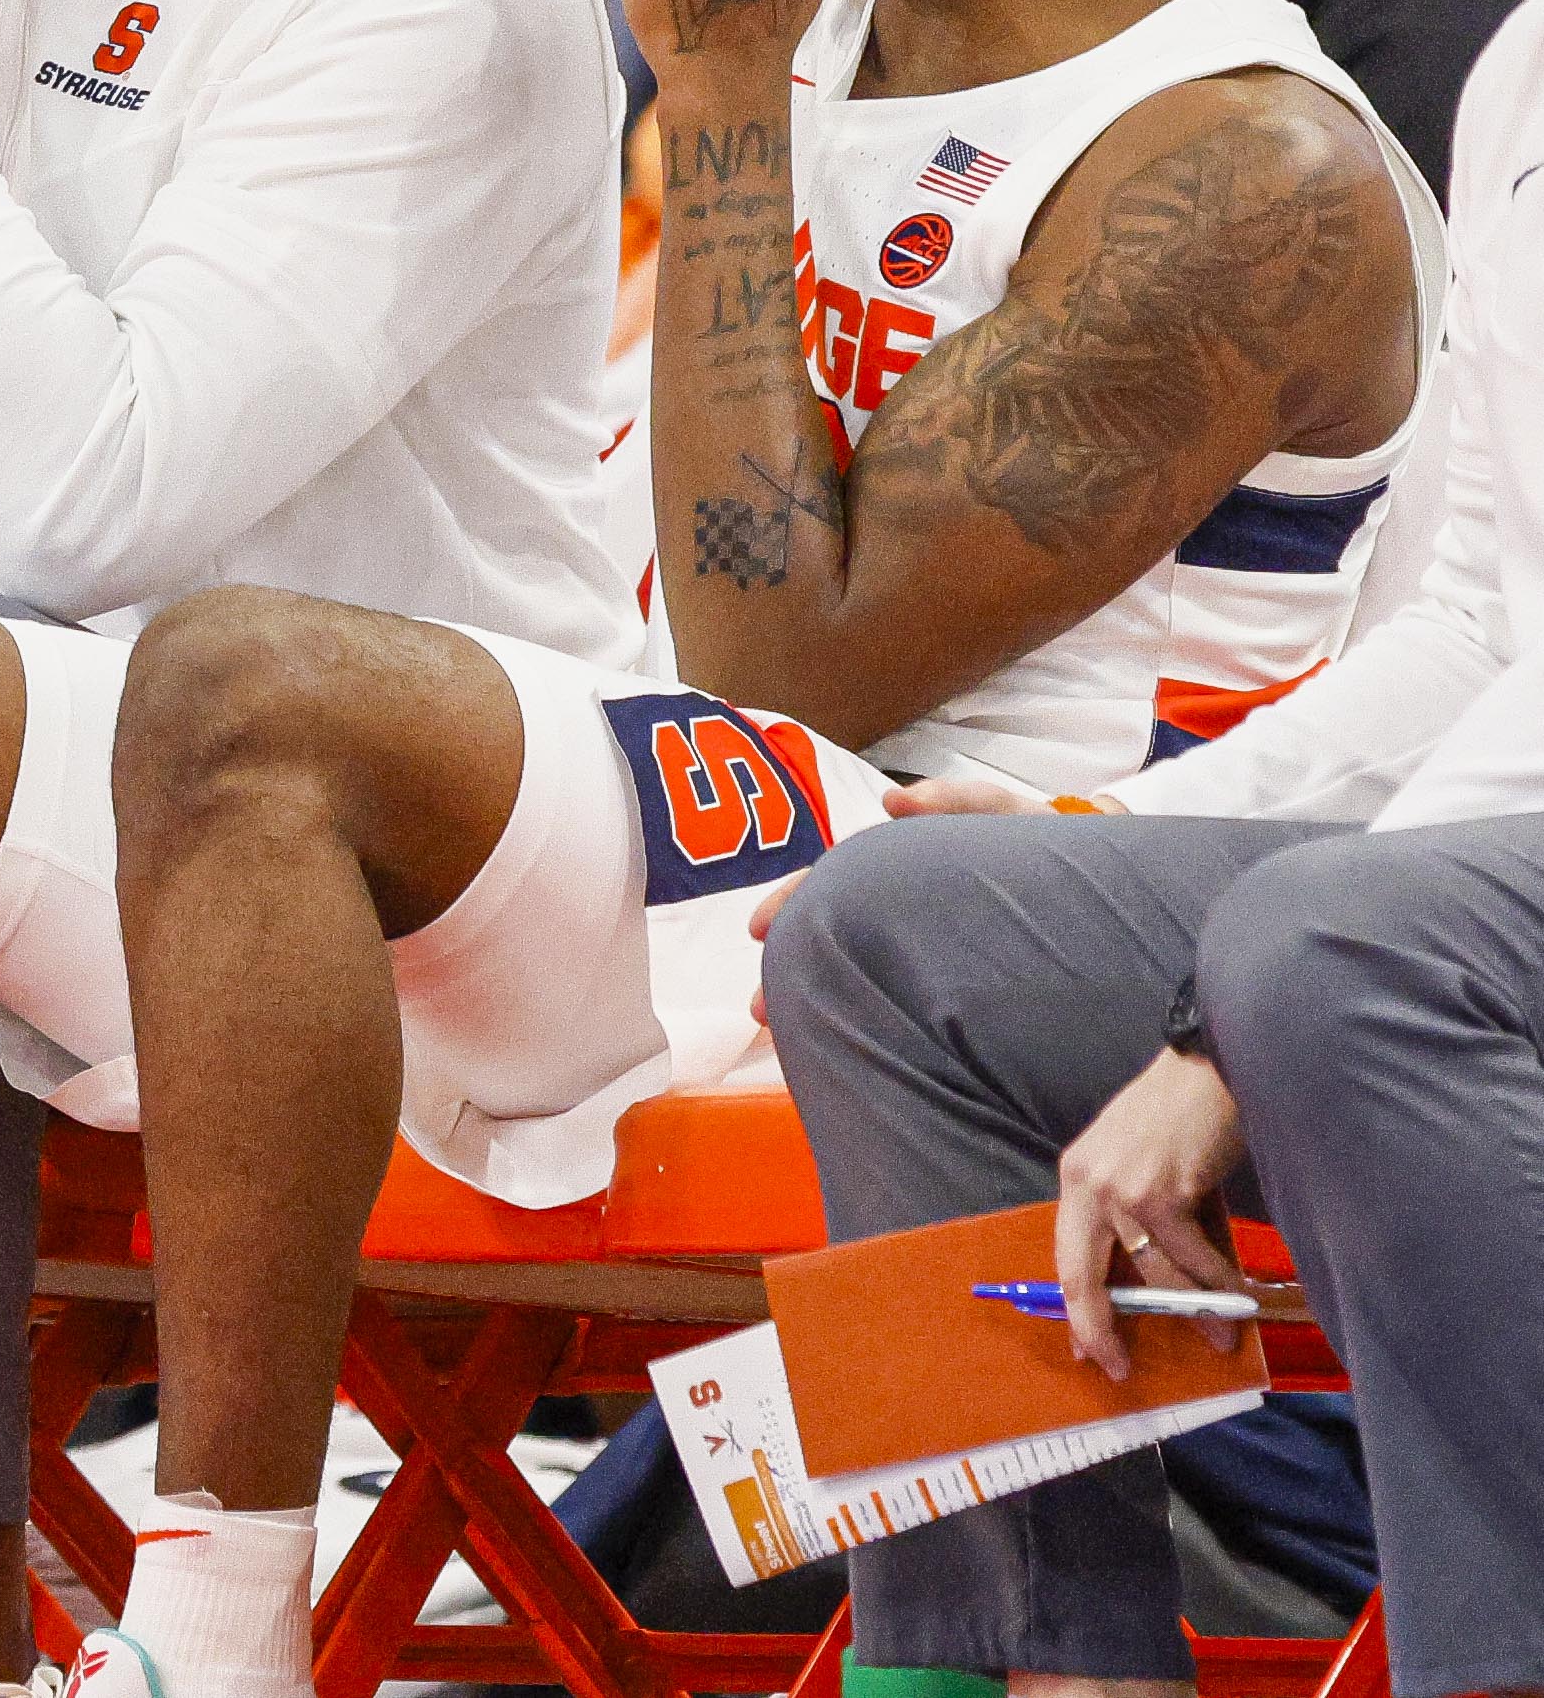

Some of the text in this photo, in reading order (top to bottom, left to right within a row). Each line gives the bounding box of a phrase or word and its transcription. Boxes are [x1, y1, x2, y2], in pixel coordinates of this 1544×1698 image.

[92, 1, 160, 76] S
[34, 60, 151, 111] SYRACUSE
[651, 714, 796, 865] S
[689, 1379, 722, 1410] S
